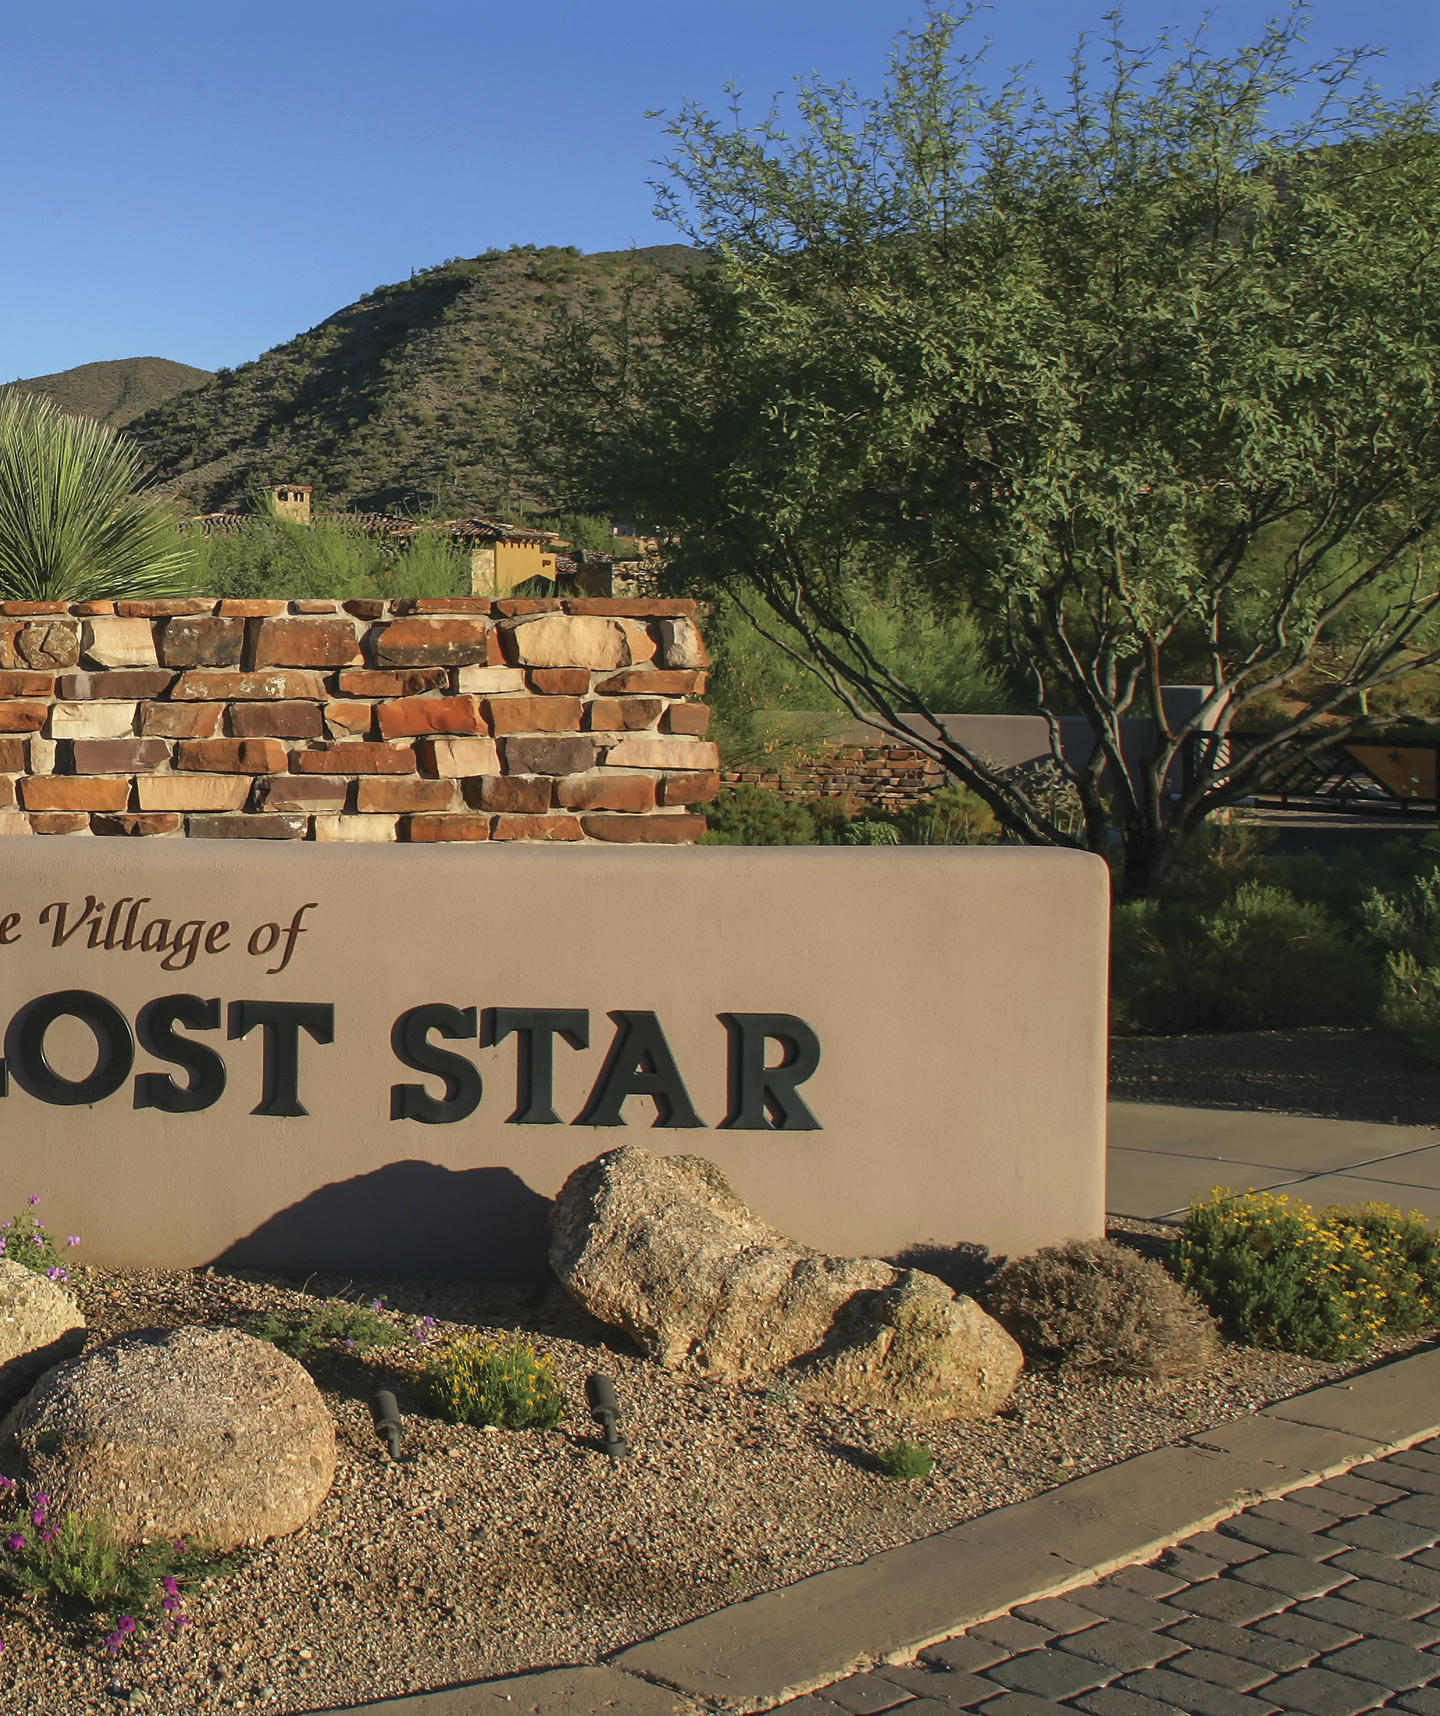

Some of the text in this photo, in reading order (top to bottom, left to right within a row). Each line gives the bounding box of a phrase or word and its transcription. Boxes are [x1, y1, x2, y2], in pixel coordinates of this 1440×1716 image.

[38, 895, 231, 972] Village
[247, 902, 320, 975] of
[389, 1002, 824, 1132] STAR
